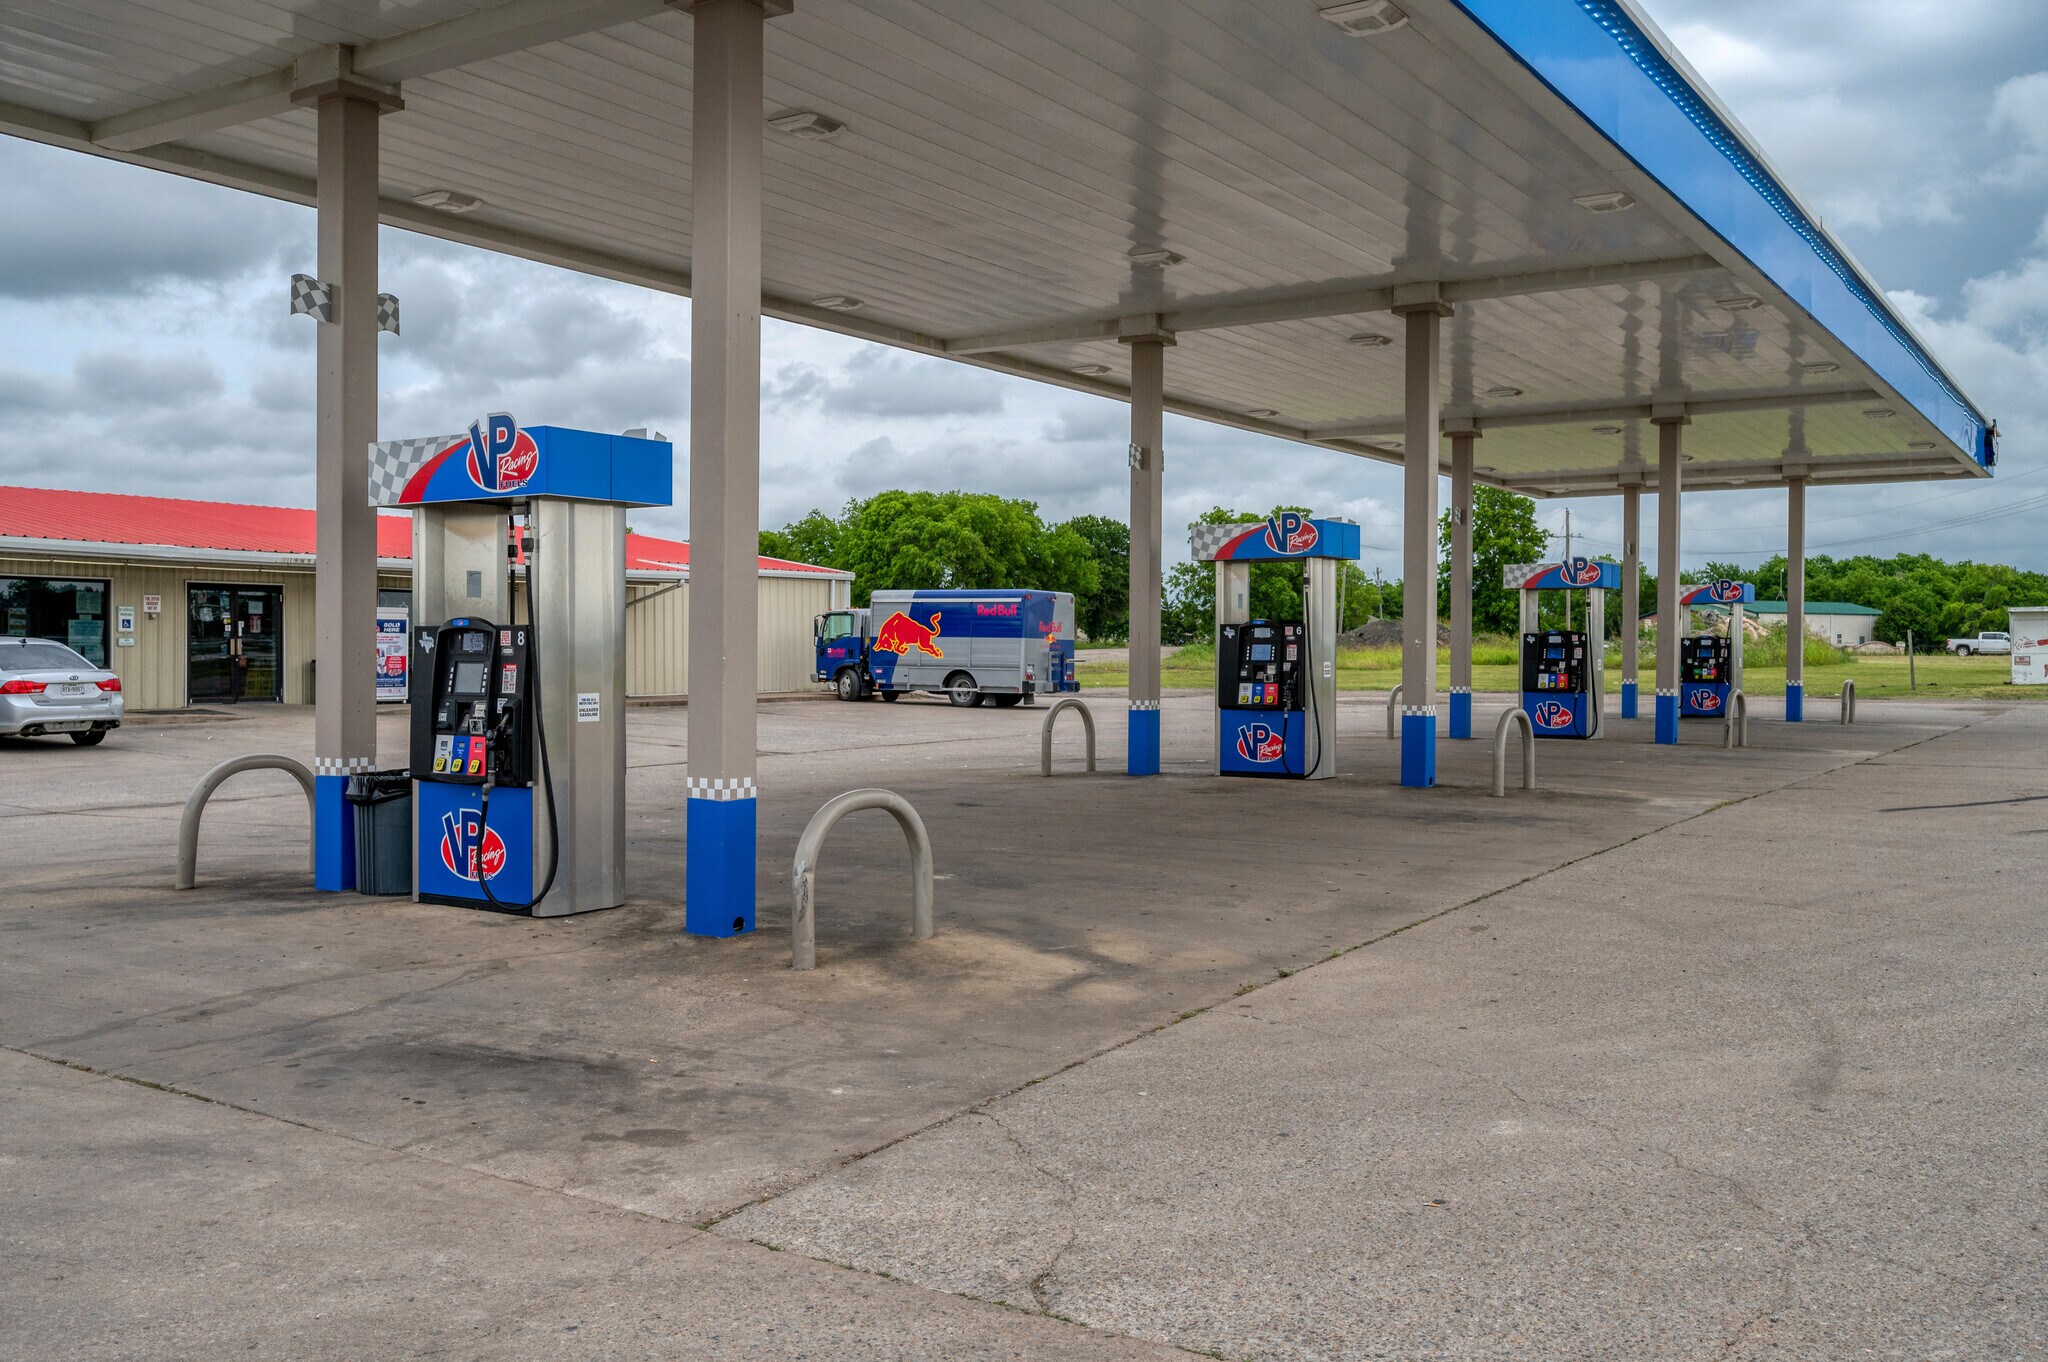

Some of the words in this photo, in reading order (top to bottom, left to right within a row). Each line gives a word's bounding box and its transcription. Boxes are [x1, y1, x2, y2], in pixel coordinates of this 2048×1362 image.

[469, 412, 517, 491] VP
[500, 450, 537, 480] Racing
[500, 479, 528, 489] FUELS
[1267, 512, 1302, 553] VP
[1290, 532, 1317, 548] Racing
[1562, 557, 1588, 585] VP
[1711, 579, 1732, 600] VP
[977, 603, 997, 616] Red
[998, 603, 1017, 616] Bull
[1039, 621, 1050, 632] Red
[1051, 622, 1062, 633] Bull
[1296, 626, 1302, 635] 6
[517, 630, 526, 646] 8
[1692, 689, 1712, 709] VP
[1536, 701, 1561, 728] VP
[1238, 723, 1271, 762] VP
[1260, 743, 1283, 757] Racing
[442, 808, 487, 879] VP
[471, 847, 505, 870] Rcing
